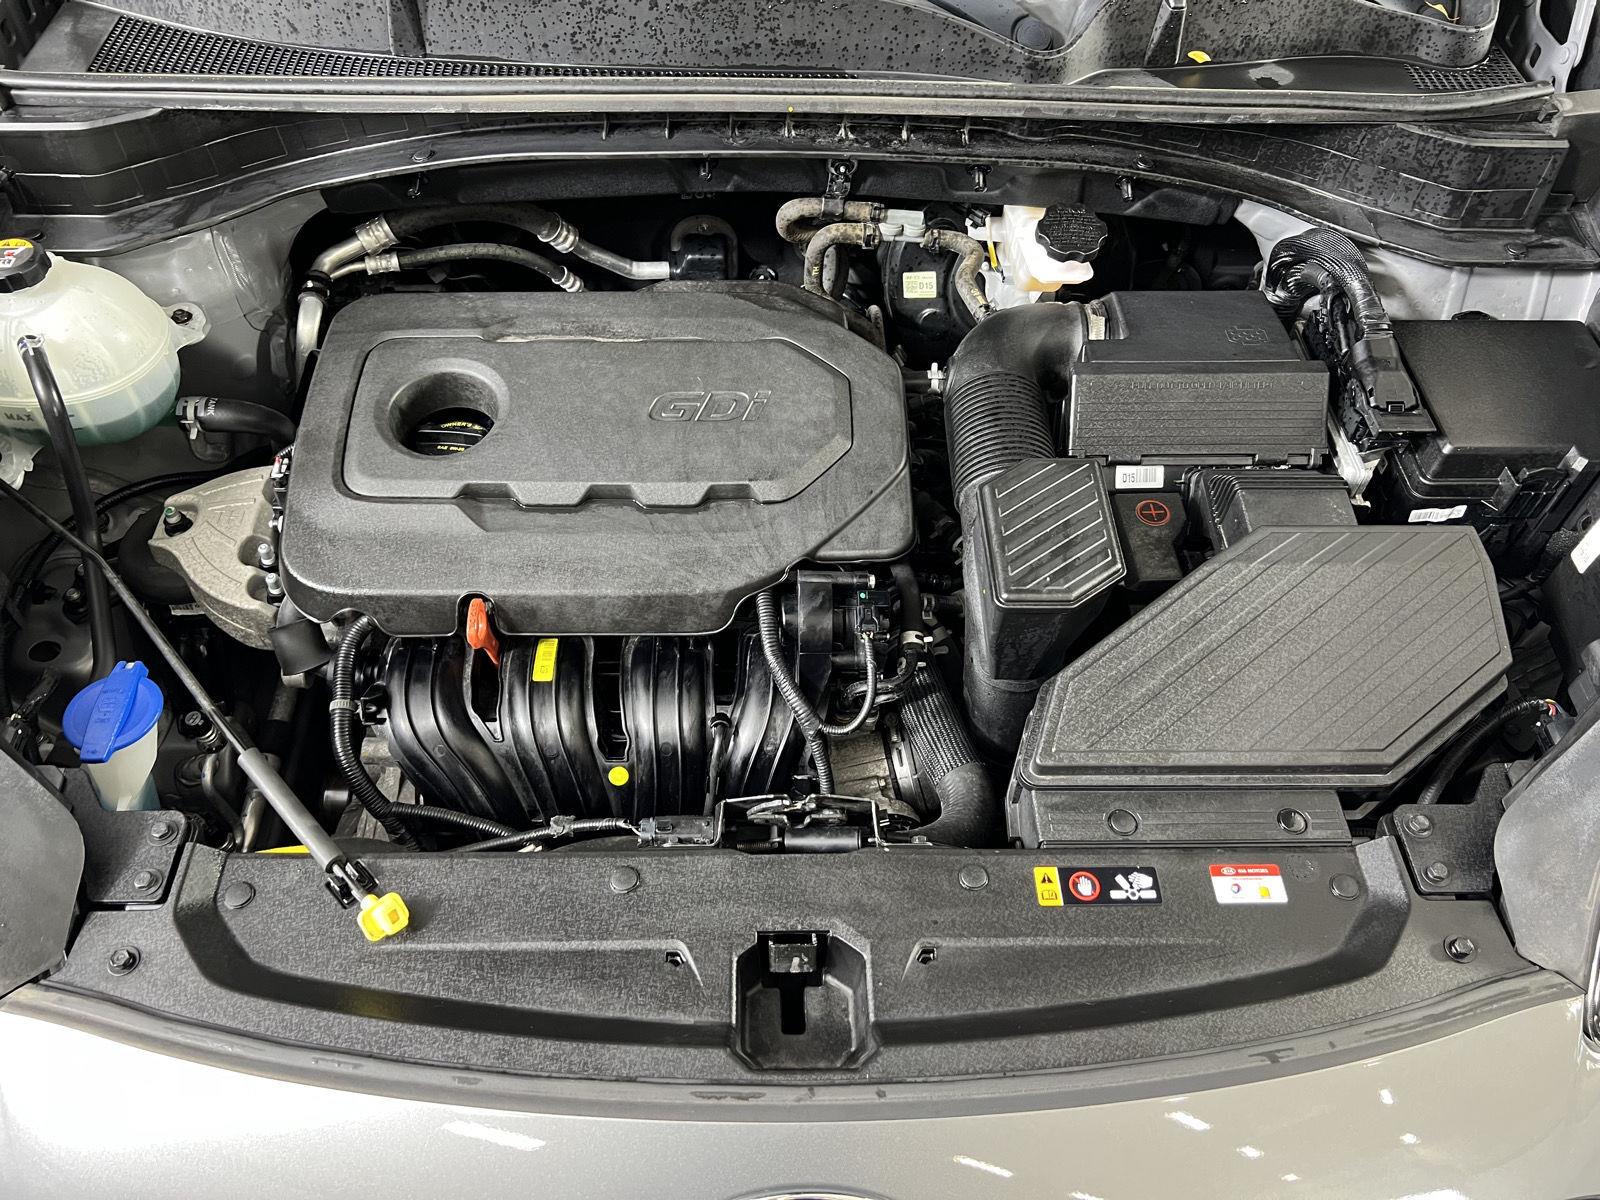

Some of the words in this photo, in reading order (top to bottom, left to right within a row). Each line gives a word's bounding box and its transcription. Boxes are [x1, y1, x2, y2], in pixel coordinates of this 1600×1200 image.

[648, 390, 772, 421] GDi
[3, 411, 35, 422] MAX
[1121, 473, 1137, 484] D15
